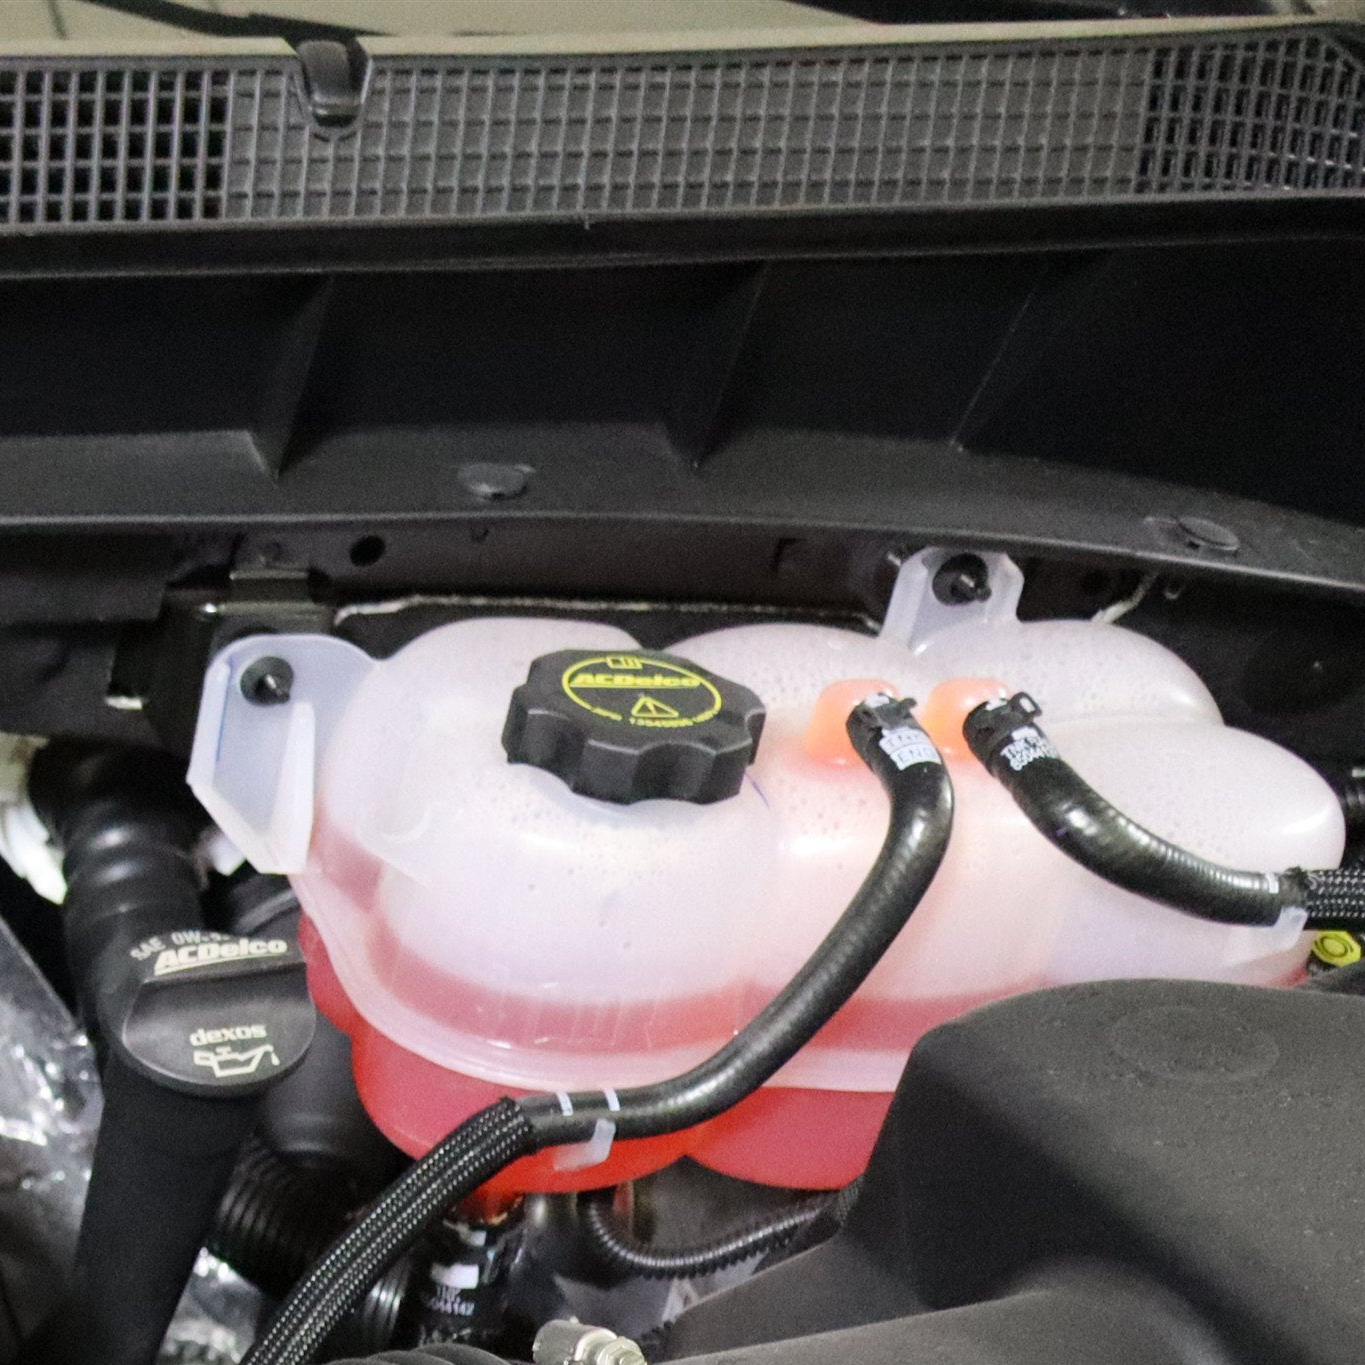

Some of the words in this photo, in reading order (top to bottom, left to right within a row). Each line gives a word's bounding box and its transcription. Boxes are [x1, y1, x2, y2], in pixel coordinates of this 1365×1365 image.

[570, 672, 701, 688] ACDelco
[154, 938, 288, 976] ACDelco
[189, 1024, 267, 1046] dexos
